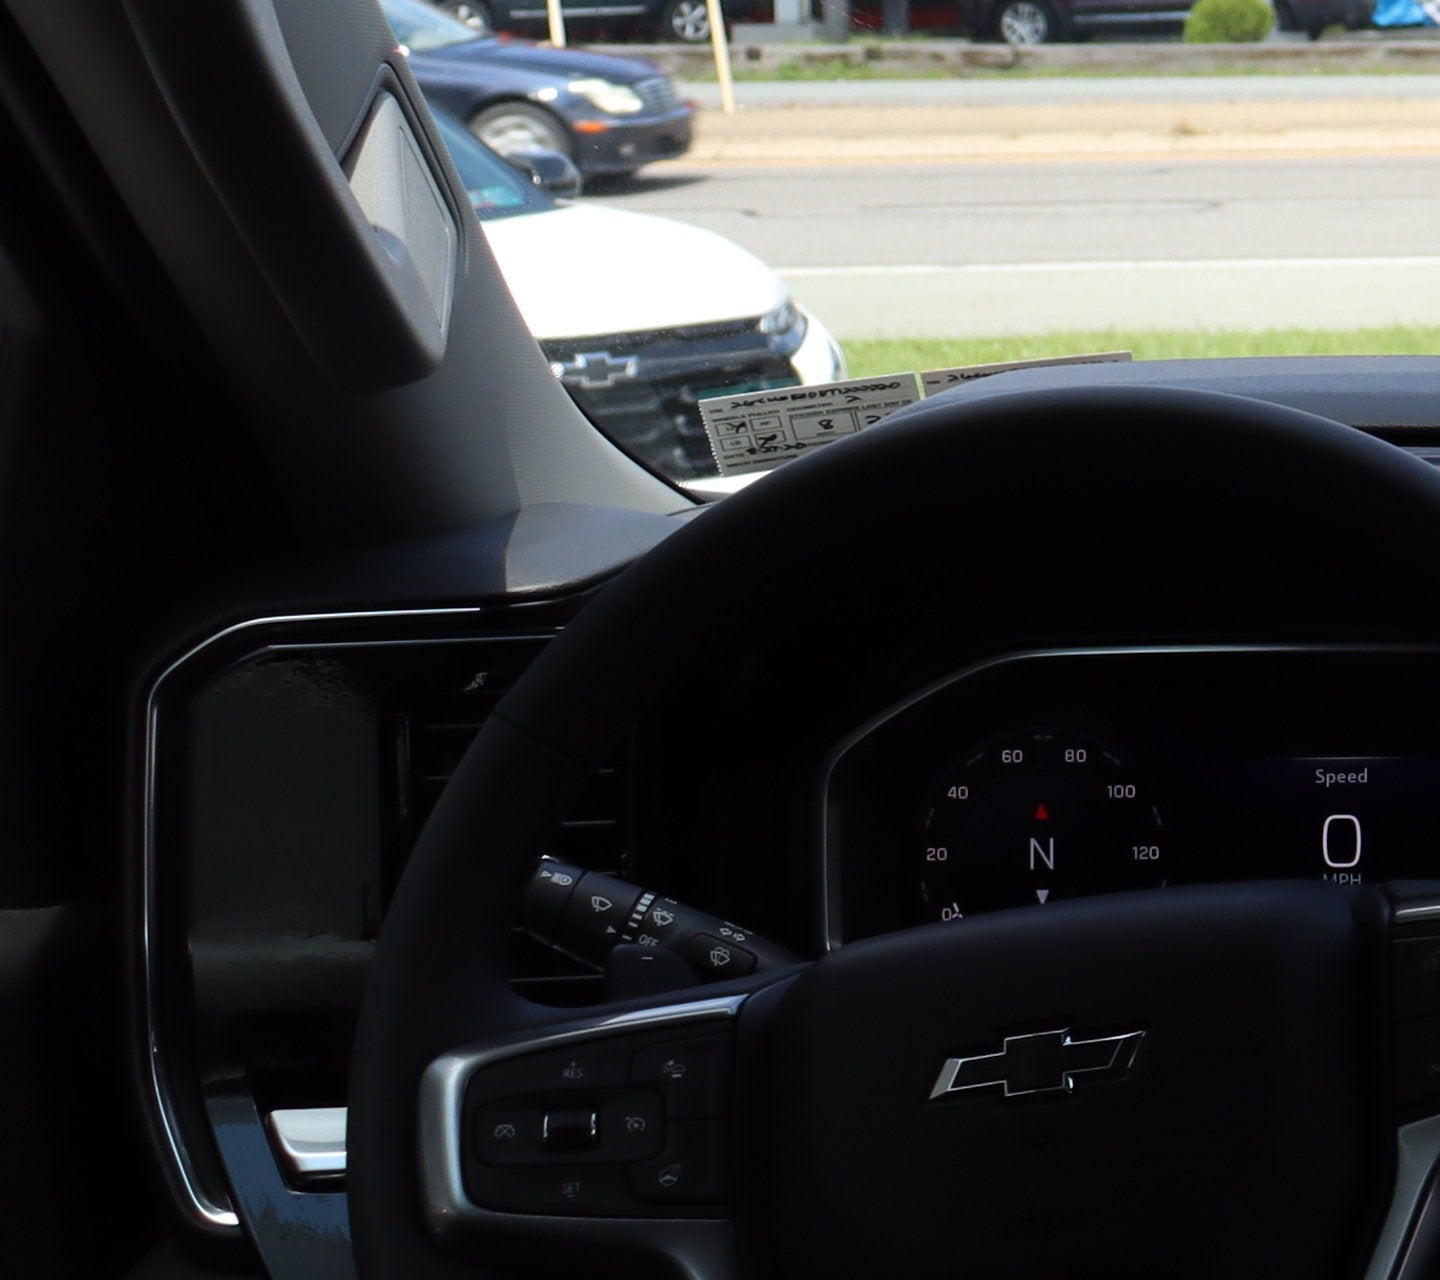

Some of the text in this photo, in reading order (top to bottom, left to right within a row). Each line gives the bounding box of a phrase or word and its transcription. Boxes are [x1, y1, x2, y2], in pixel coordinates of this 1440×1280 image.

[1002, 750, 1022, 762] 60
[1065, 749, 1086, 762] 80
[1316, 768, 1367, 787] Speed
[948, 787, 968, 799] 40
[1108, 785, 1135, 798] 100
[1323, 815, 1361, 867] 0
[927, 848, 947, 860] 20
[1031, 838, 1053, 869] N
[1133, 846, 1159, 859] 120
[563, 1067, 583, 1079] RES
